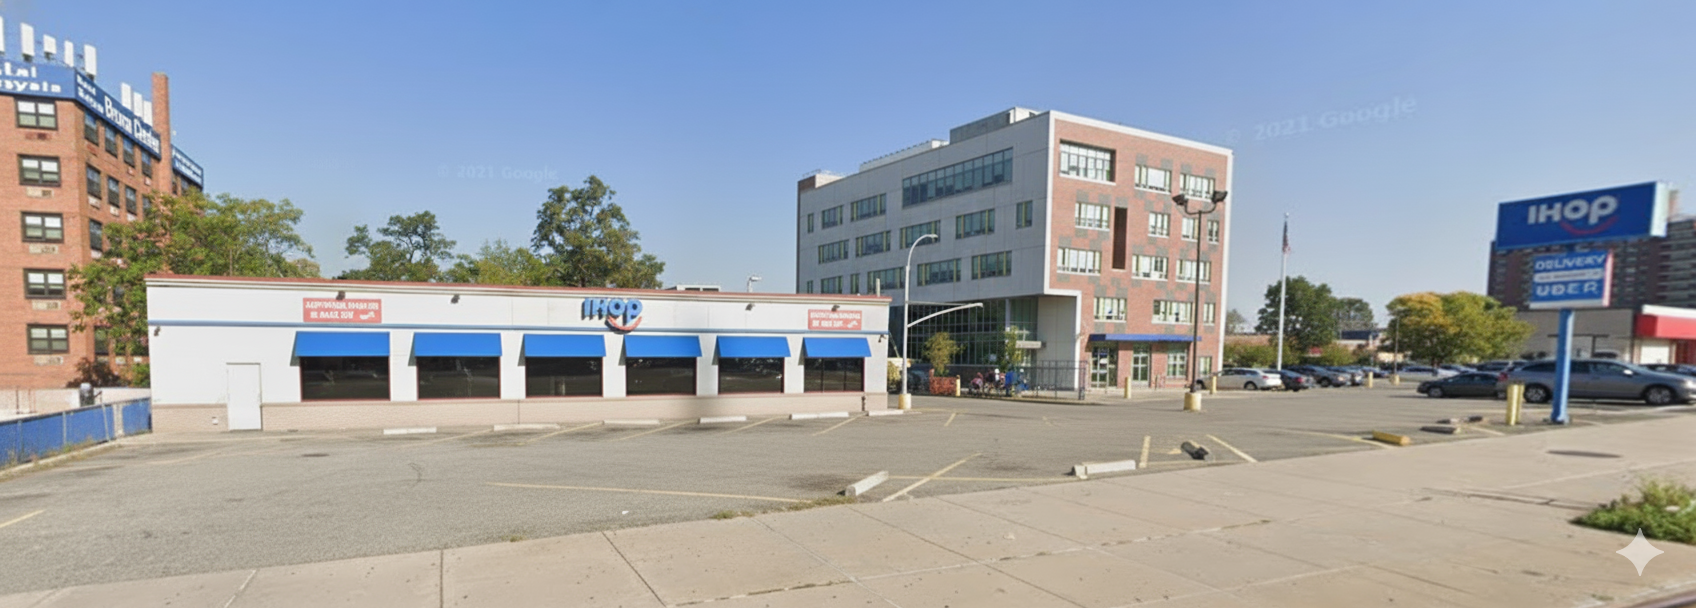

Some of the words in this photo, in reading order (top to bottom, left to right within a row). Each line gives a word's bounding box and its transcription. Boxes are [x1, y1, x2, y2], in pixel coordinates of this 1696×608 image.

[1527, 195, 1618, 225] IHOP
[1535, 254, 1605, 270] DELIVERY
[1537, 281, 1599, 297] UBER
